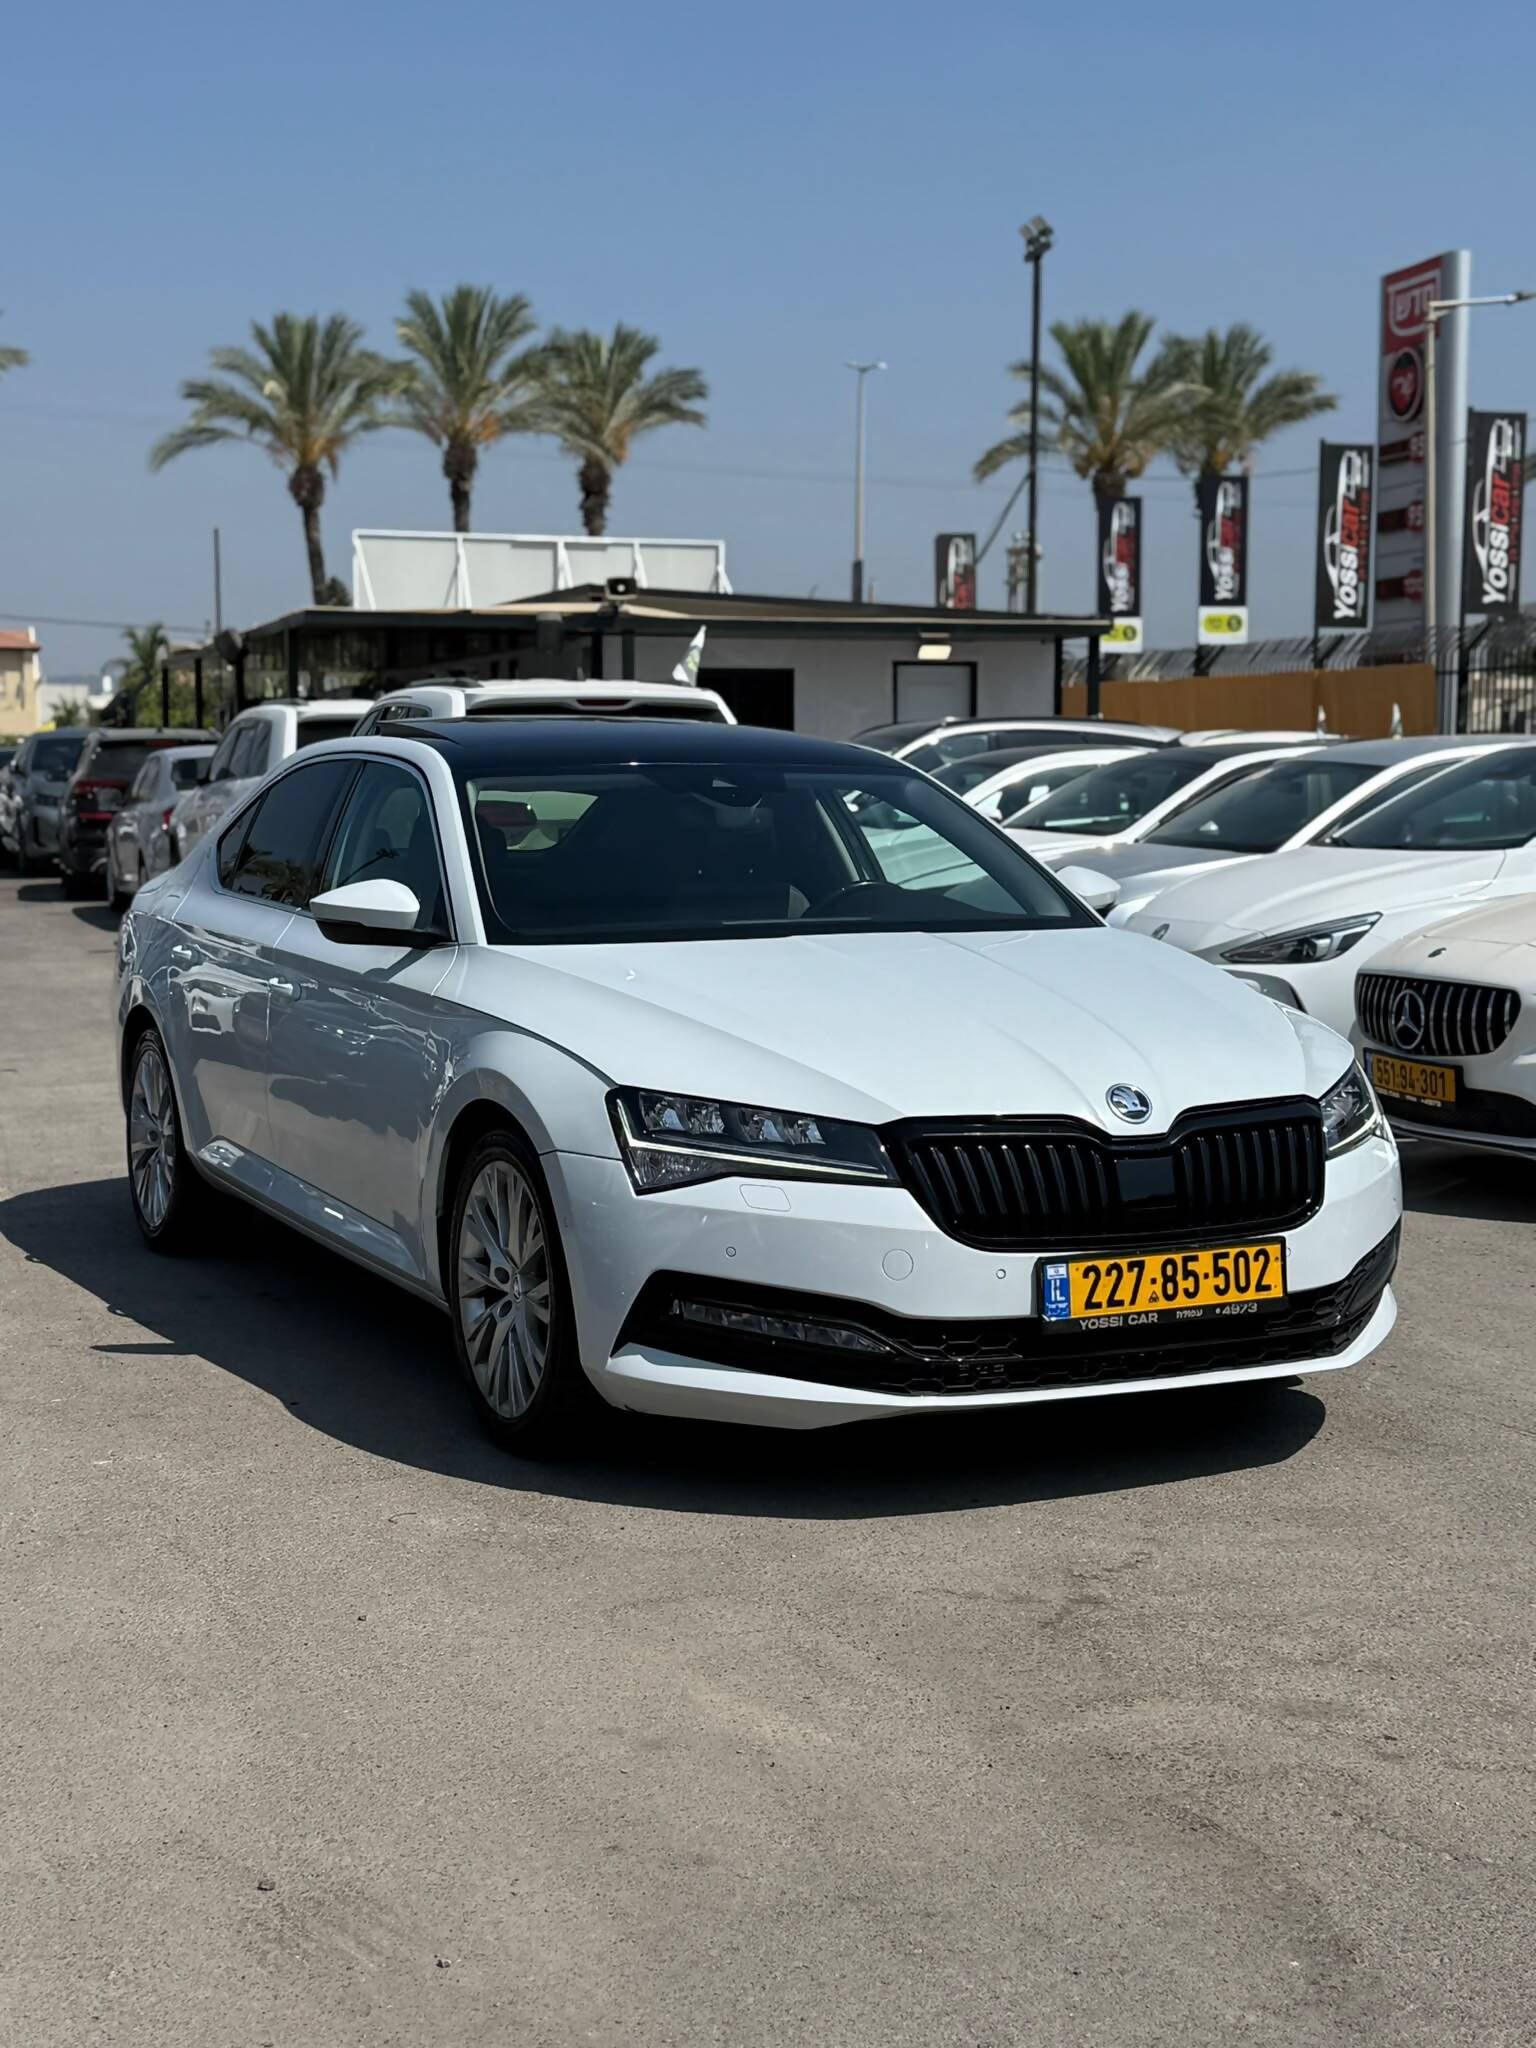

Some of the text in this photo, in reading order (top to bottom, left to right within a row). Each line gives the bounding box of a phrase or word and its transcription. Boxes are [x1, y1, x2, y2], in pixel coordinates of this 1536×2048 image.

[1051, 1279, 1066, 1302] IL
[1079, 1313, 1158, 1331] YOSSI CAR
